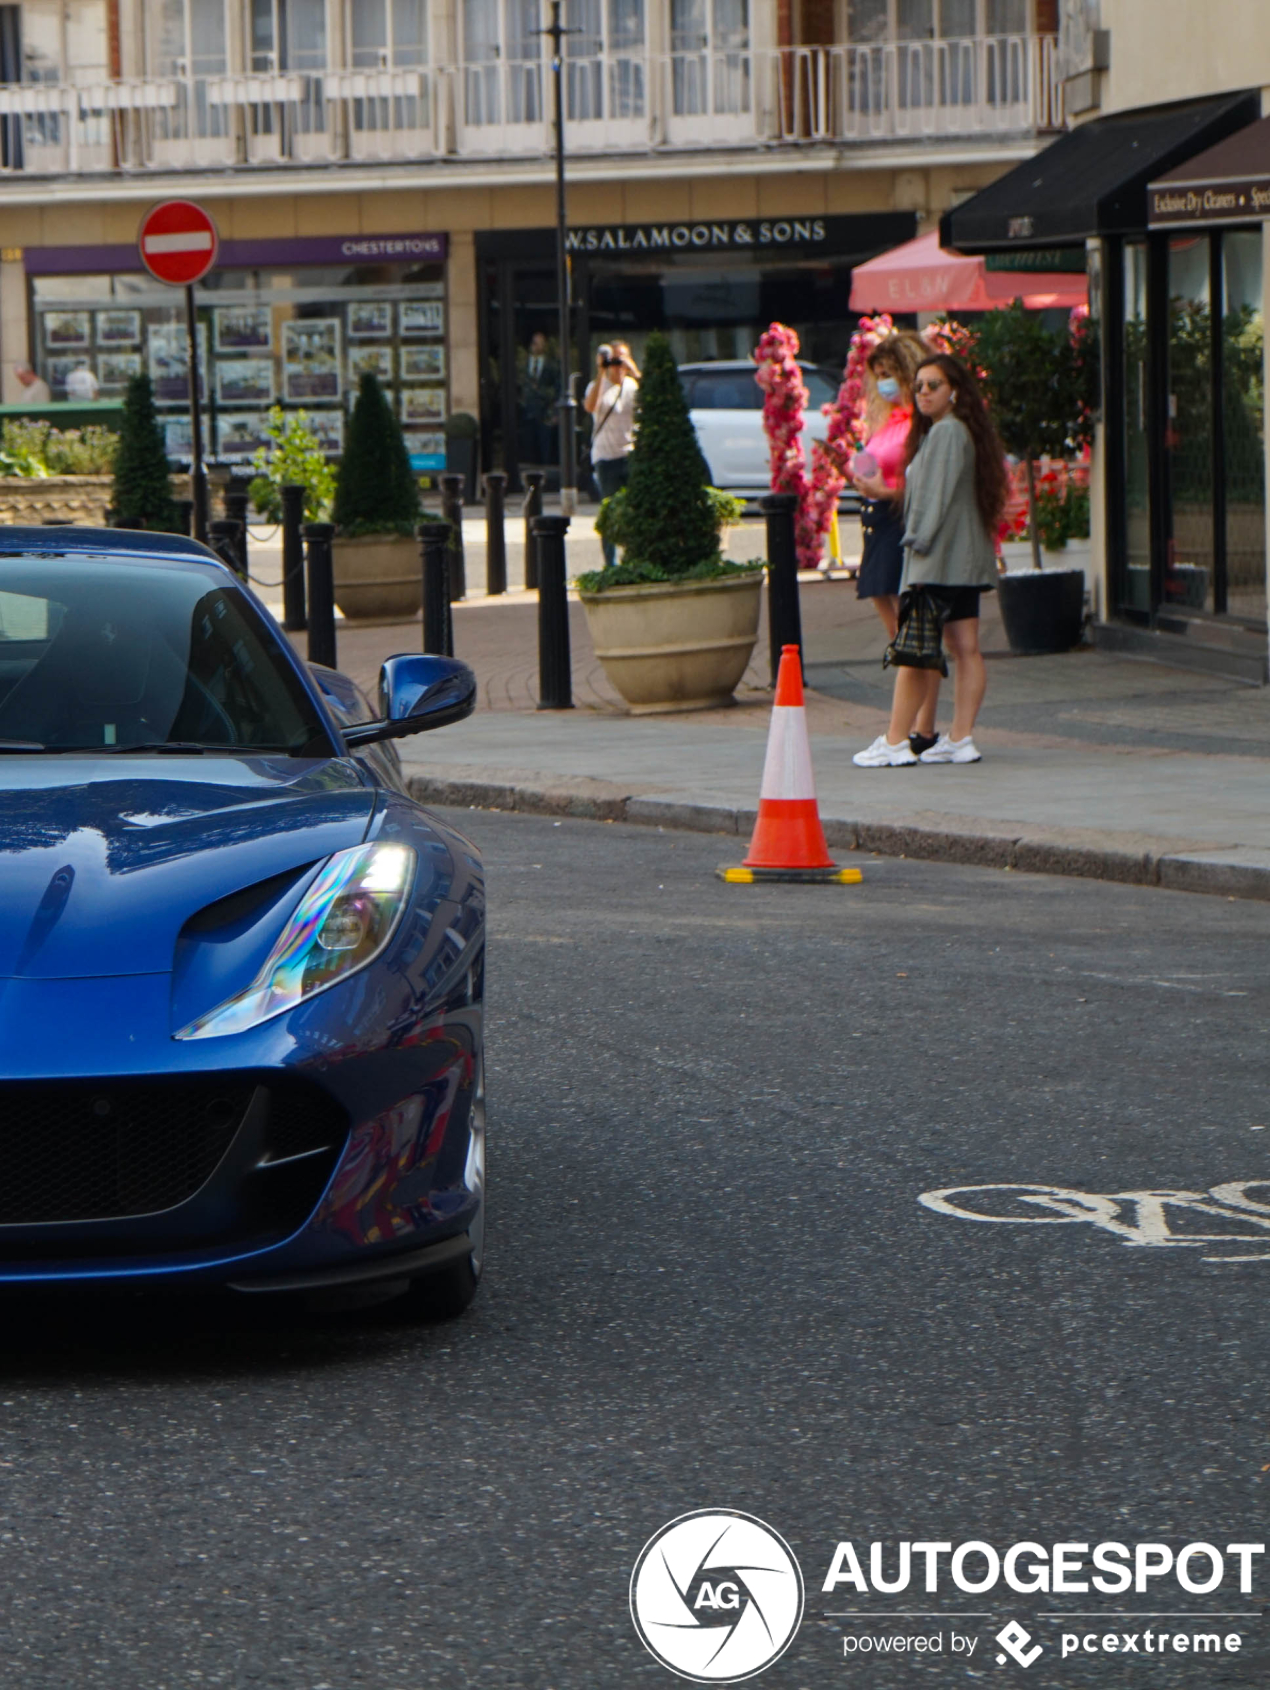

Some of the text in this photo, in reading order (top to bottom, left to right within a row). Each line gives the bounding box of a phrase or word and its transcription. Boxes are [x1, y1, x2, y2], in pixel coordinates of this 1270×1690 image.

[1154, 190, 1236, 217] Exclusive Dry Cleaners
[733, 223, 754, 244] &
[759, 220, 826, 243] SONS
[341, 238, 440, 256] CHESTERTONS
